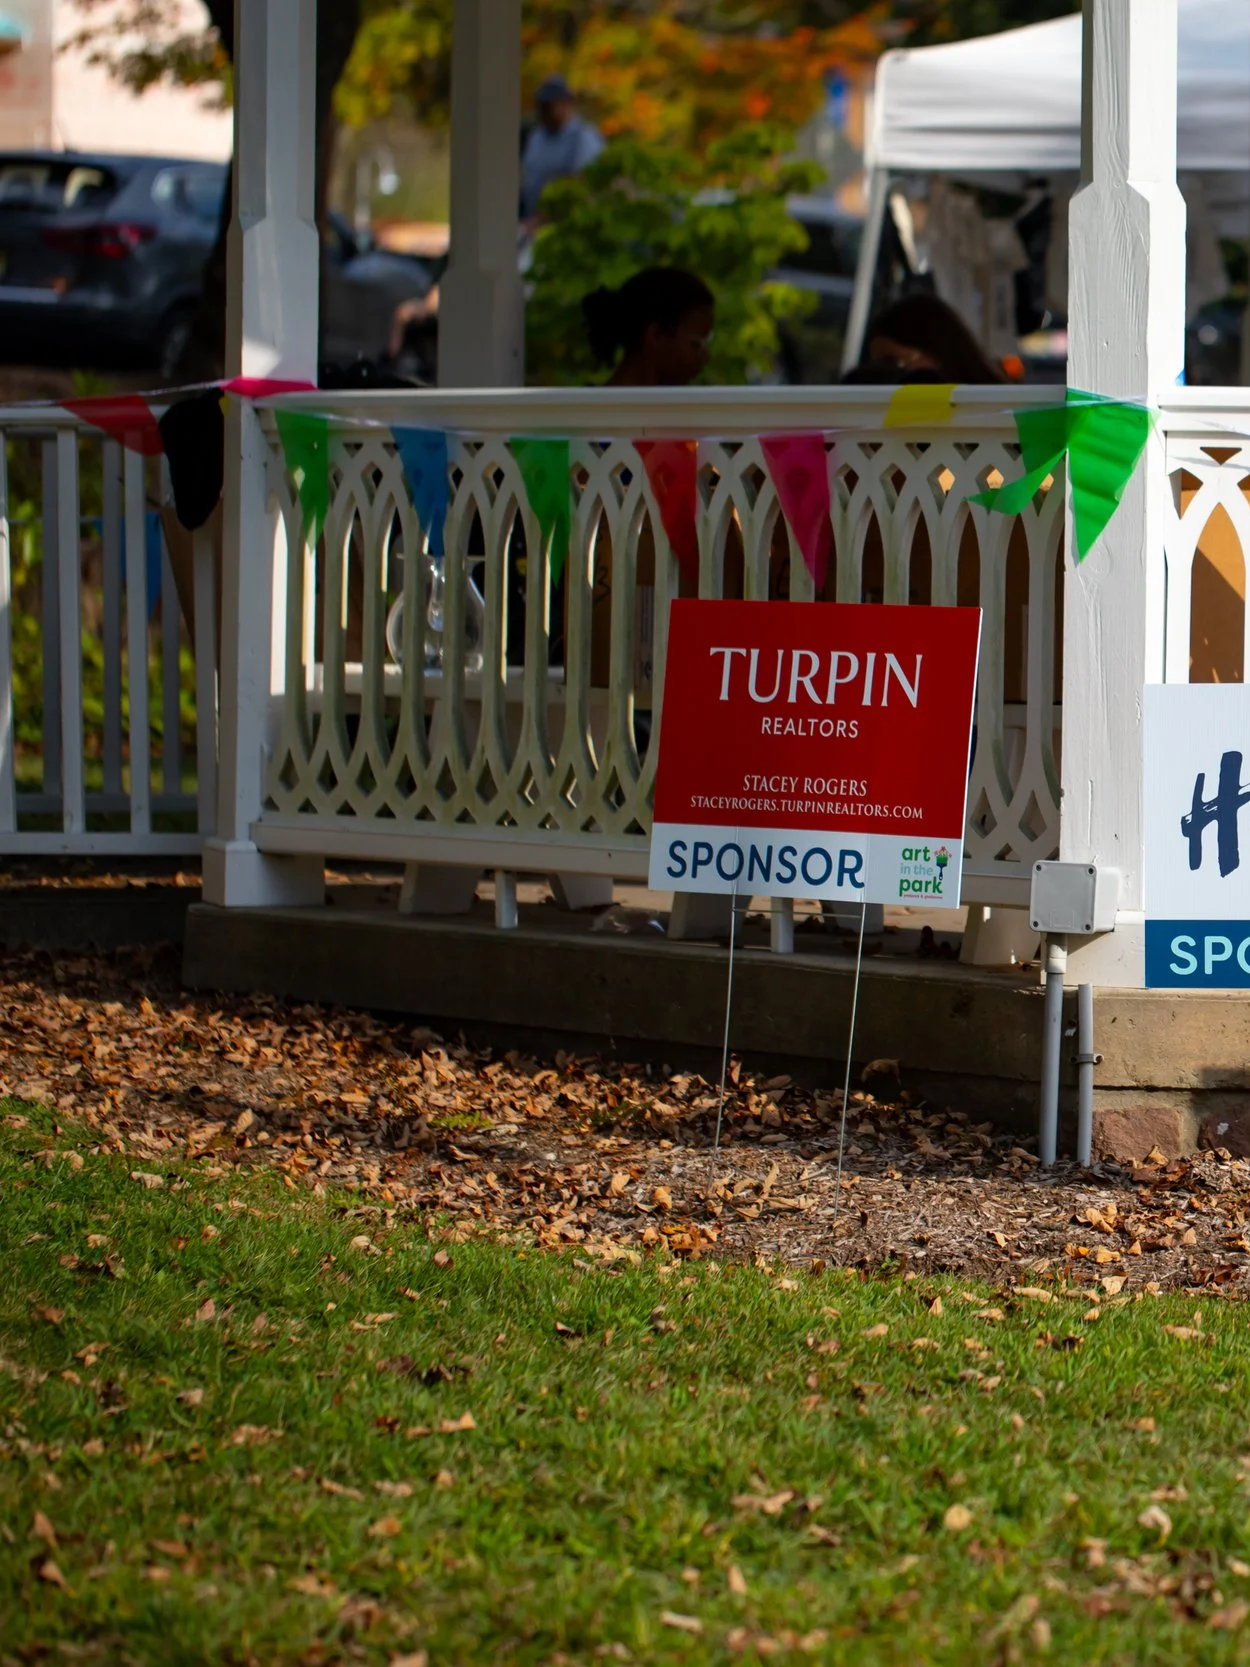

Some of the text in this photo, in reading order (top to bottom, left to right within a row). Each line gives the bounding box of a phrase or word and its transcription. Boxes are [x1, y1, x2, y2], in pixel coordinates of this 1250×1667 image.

[709, 646, 923, 708] TURPIN
[761, 717, 859, 738] REALTORS
[743, 774, 868, 797] STACEY ROGERS
[690, 795, 924, 819] STACEYROGERS.TURPINREALTORS.COM
[667, 839, 865, 889] SPONSOR
[902, 846, 931, 862] art
[900, 863, 933, 876] in the
[899, 876, 943, 897] park
